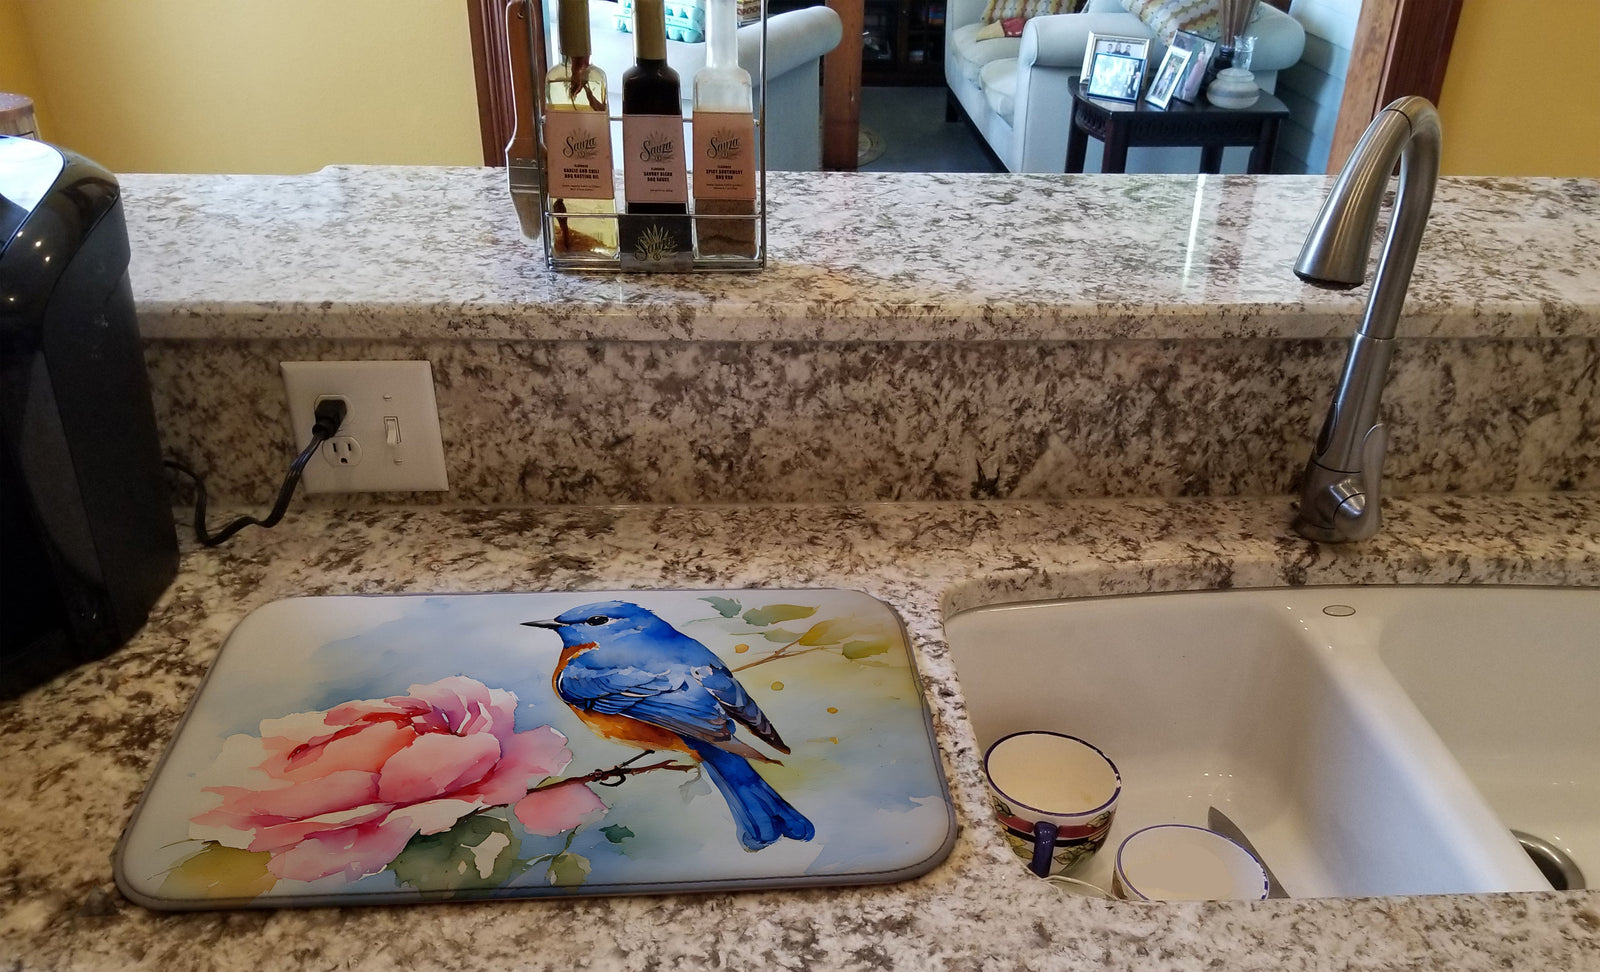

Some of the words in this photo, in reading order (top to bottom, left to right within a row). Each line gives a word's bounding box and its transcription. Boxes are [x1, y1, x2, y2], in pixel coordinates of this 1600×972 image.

[562, 136, 597, 158] Sauza
[639, 140, 673, 162] Sauza
[707, 136, 740, 159] Sauza
